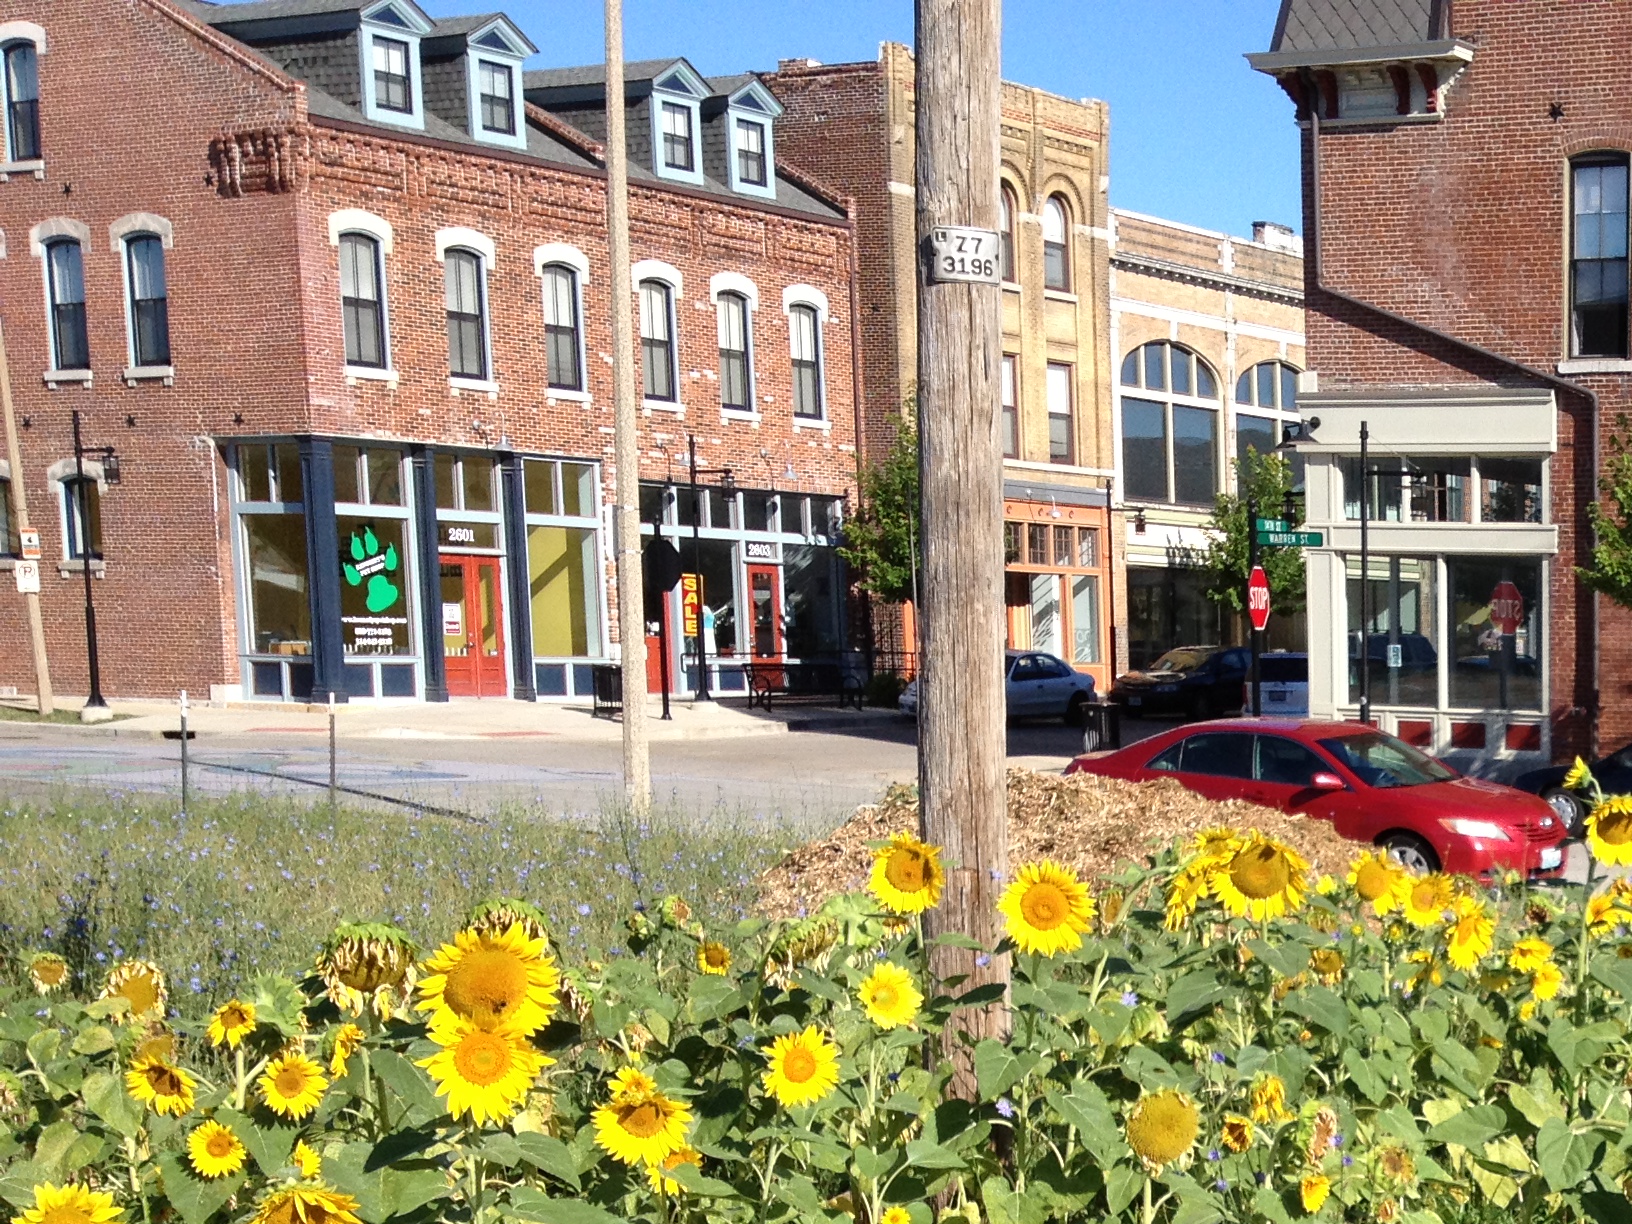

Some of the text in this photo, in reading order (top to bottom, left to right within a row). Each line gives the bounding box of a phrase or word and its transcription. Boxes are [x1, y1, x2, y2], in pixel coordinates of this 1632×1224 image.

[955, 235, 982, 254] Z7
[942, 256, 993, 276] 3196
[448, 528, 475, 541] 2601
[1269, 533, 1296, 543] WARREN
[683, 578, 698, 632] SALE
[1250, 586, 1268, 609] STOP
